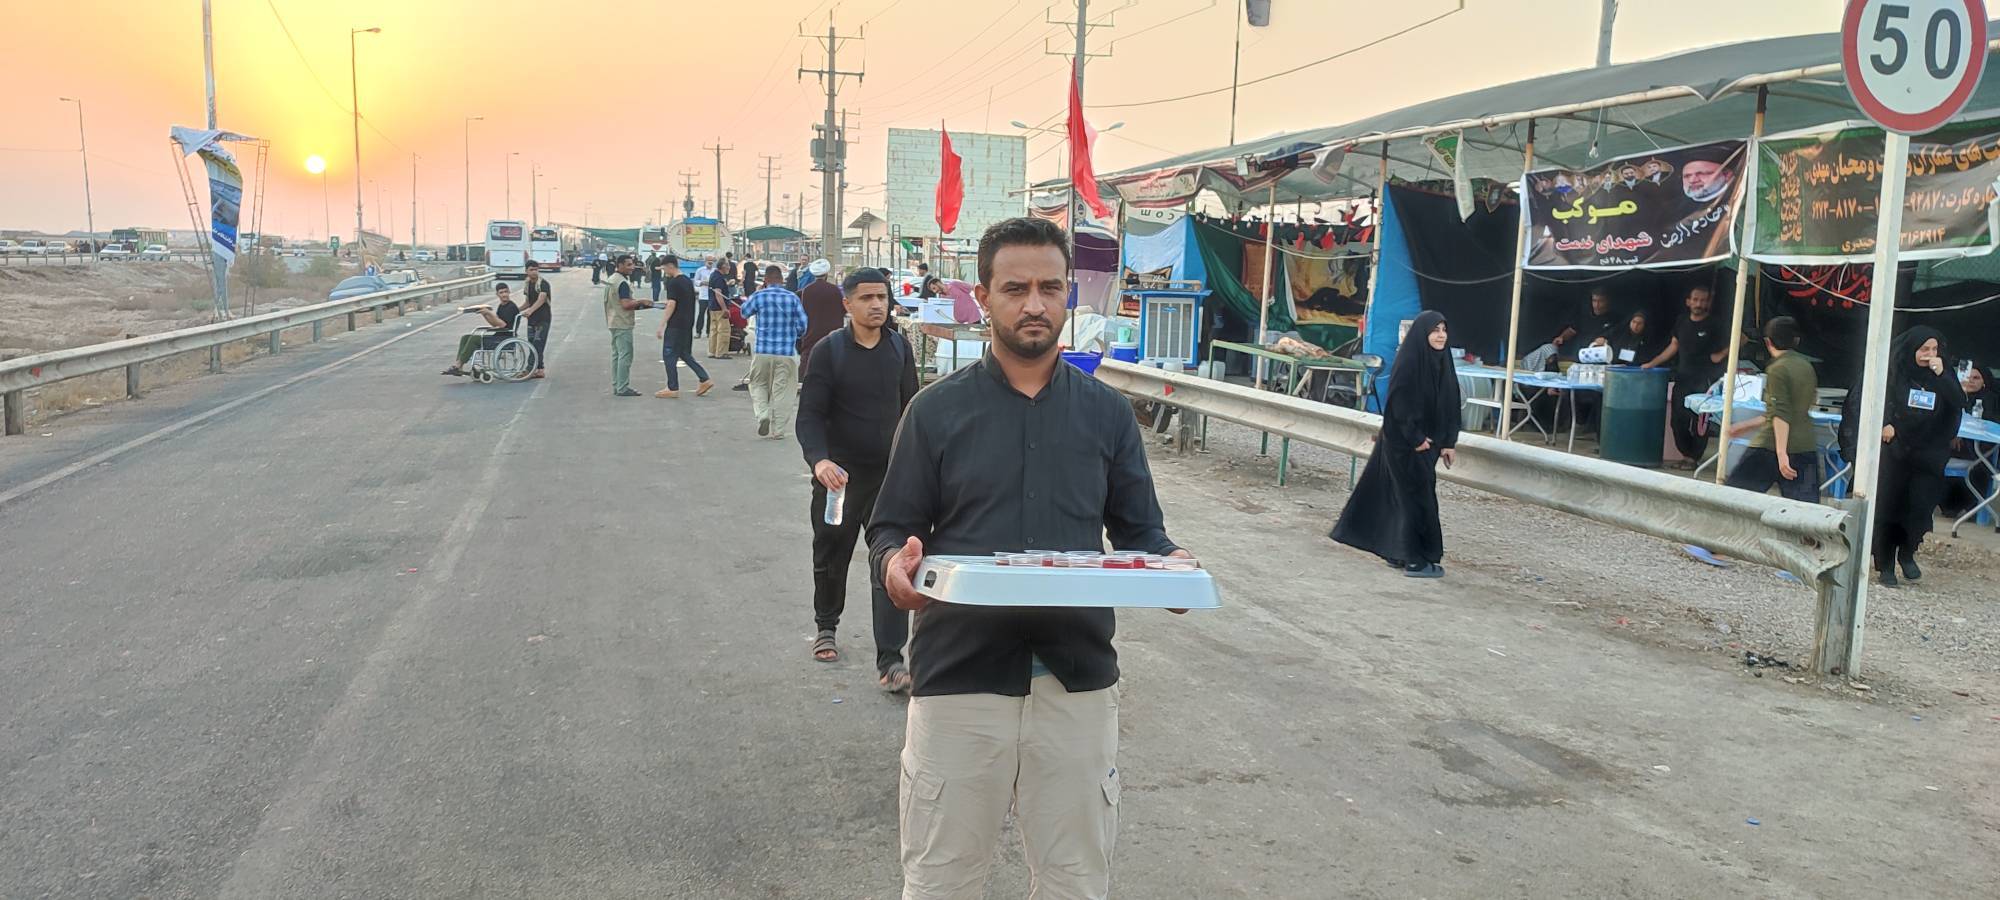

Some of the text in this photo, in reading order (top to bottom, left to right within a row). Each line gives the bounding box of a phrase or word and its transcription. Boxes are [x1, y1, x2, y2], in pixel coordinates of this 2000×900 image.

[1870, 4, 1961, 79] 50
[1552, 196, 1639, 225] موکب
[1555, 231, 1652, 254] شهدای خدمت
